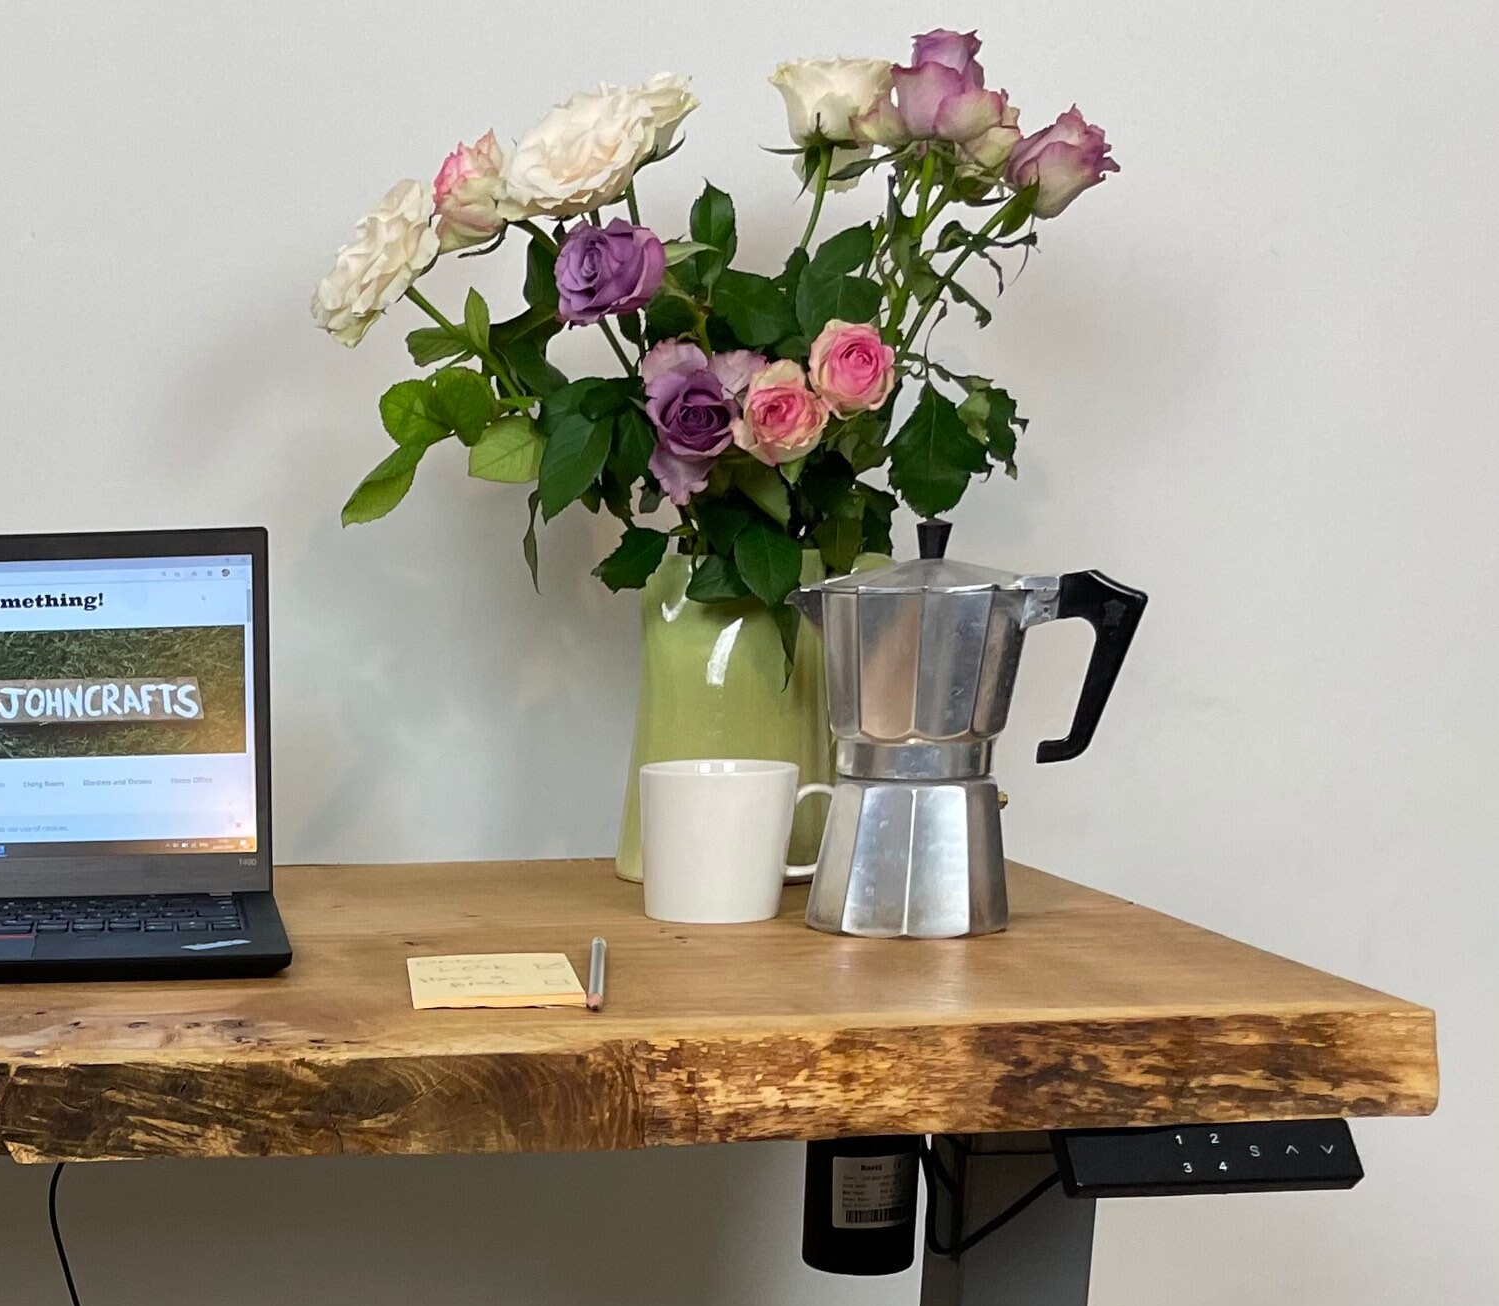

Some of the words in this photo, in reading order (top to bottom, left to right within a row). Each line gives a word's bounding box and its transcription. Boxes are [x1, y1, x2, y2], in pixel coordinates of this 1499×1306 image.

[1175, 1134, 1183, 1145] 1
[1209, 1133, 1220, 1144] 2
[1249, 1145, 1261, 1157] S
[1183, 1162, 1193, 1173] 3
[1218, 1161, 1228, 1171] 4
